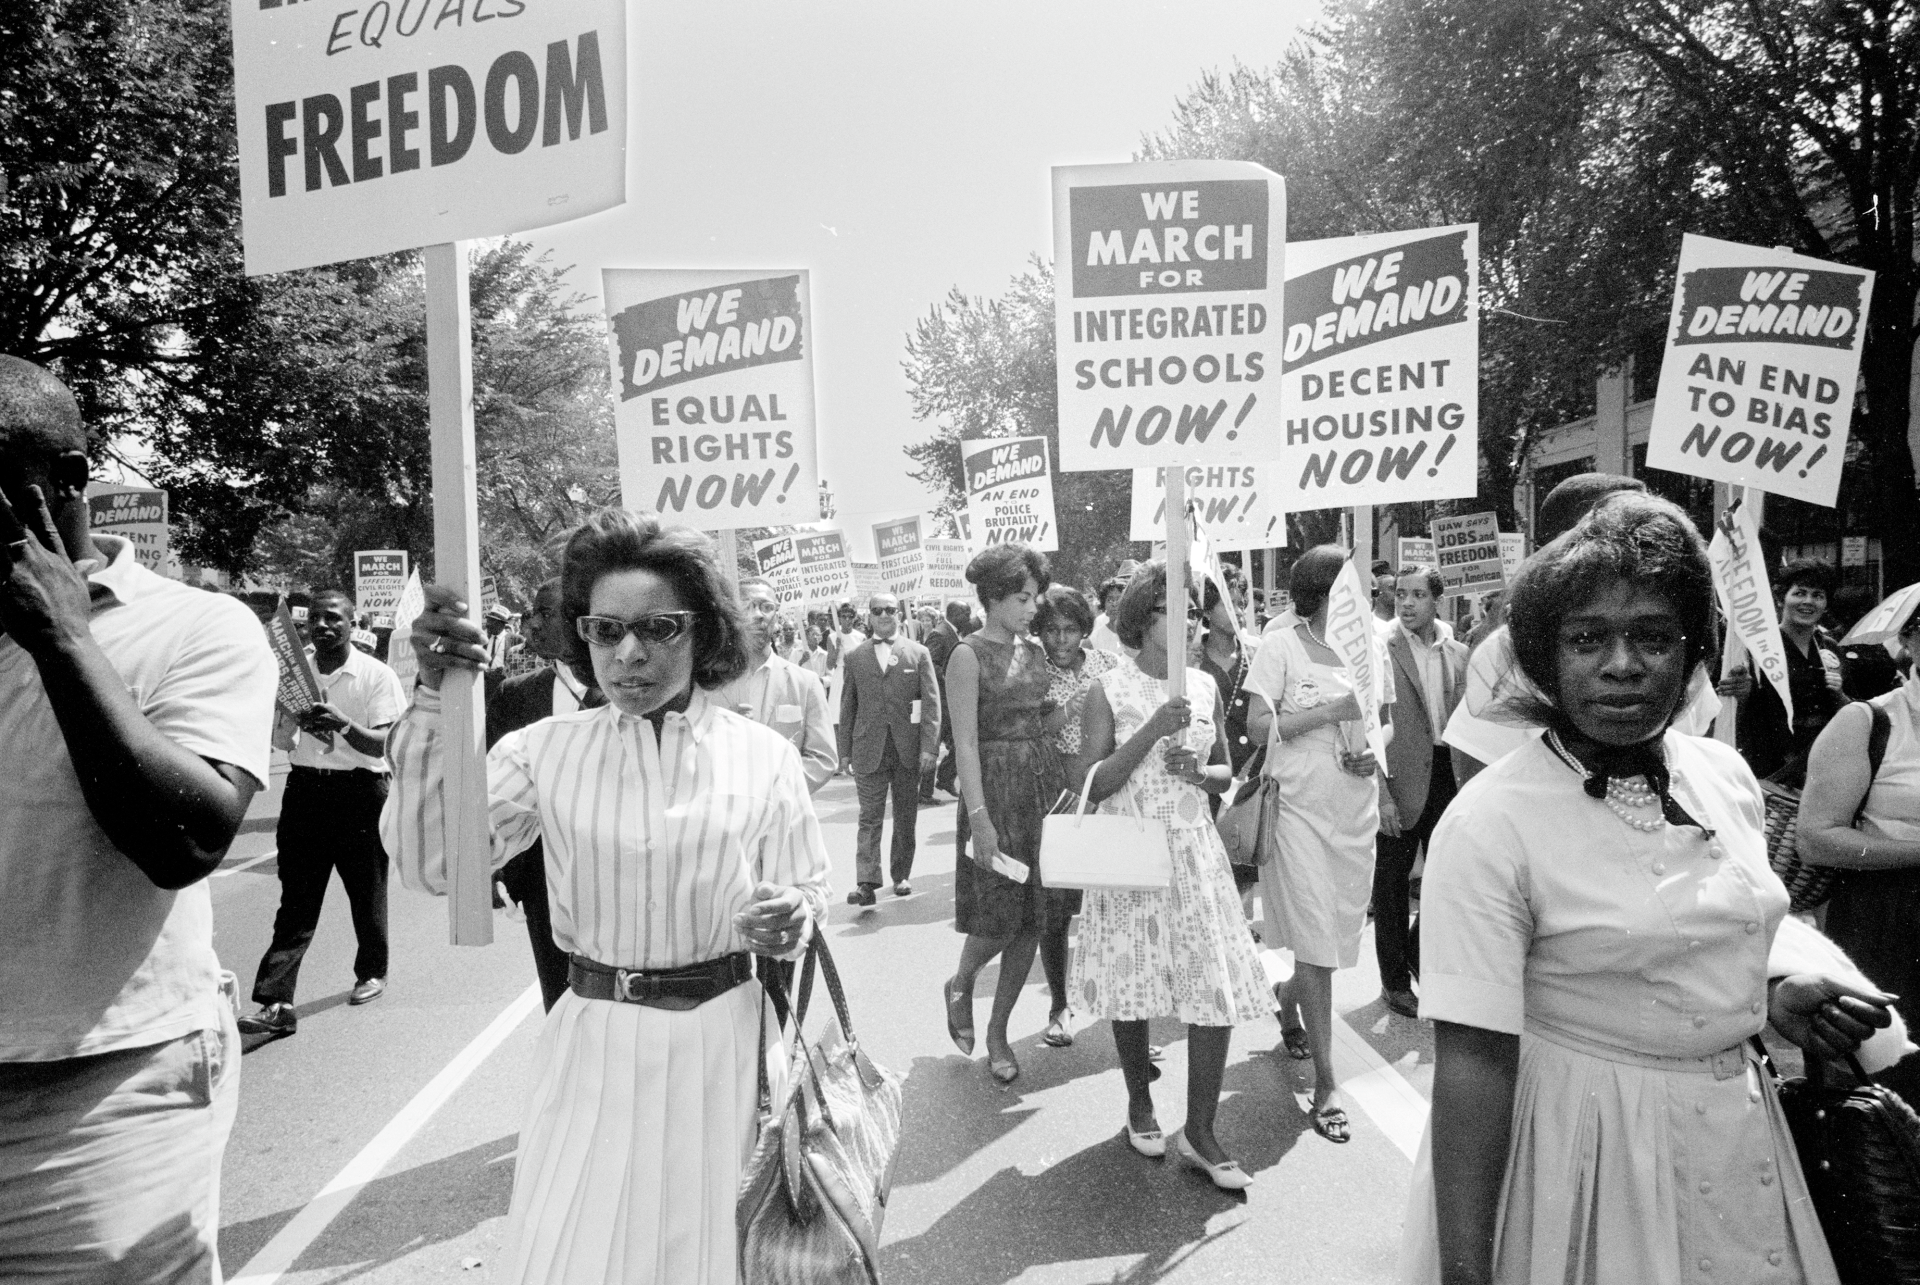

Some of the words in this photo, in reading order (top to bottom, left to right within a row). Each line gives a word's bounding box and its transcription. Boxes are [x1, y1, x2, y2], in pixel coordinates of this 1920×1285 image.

[265, 29, 608, 199] FREEDOM
[1141, 190, 1199, 221] WE
[1086, 224, 1253, 266] MARCH
[1139, 269, 1204, 288] FOR
[1332, 251, 1404, 305] WE
[1739, 270, 1810, 302] WE
[676, 288, 743, 334] WE
[1283, 275, 1462, 363] DEMAND
[1687, 303, 1853, 338] DEMAND
[1073, 303, 1267, 343] INTEGRATED
[632, 316, 797, 386] DEMAND
[1074, 351, 1265, 391] SCHOOLS
[1301, 359, 1451, 401] DECENT
[1687, 352, 1747, 386] AN
[1759, 364, 1841, 405] END
[651, 393, 787, 426] EQUAL
[1089, 392, 1257, 449] NOW!
[1687, 385, 1736, 418] TO
[1746, 397, 1833, 440] BIAS
[1286, 402, 1465, 446] HOUSING
[651, 430, 794, 464] RIGHTS
[991, 443, 1020, 466] WE
[1680, 423, 1828, 479] NOW!
[973, 455, 1043, 490] DEMAND
[1298, 433, 1457, 490] NOW!
[655, 462, 801, 514] NOW!
[1155, 466, 1255, 488] RGHTS
[112, 494, 140, 508] WE
[980, 491, 1005, 502] AN
[1008, 488, 1040, 500] END
[93, 505, 161, 525] DEMAND
[994, 504, 1032, 516] POLICE
[1153, 491, 1257, 525] W!
[892, 526, 904, 535] WE
[984, 514, 1039, 528] BRUTALITY
[1438, 521, 1463, 532] UAW
[1466, 517, 1490, 527] SAYS
[811, 537, 826, 546] WE
[882, 532, 917, 549] MARCH
[985, 521, 1049, 546] NOW!
[1437, 530, 1477, 549] JOBS
[1479, 531, 1495, 541] and
[772, 540, 790, 555] WE
[801, 543, 840, 557] MARCH
[893, 545, 907, 553] FOR
[1404, 549, 1435, 557] MARCH
[1439, 545, 1499, 566] FREEDOM
[361, 562, 400, 572] MARCH
[763, 549, 795, 571] DEMA
[801, 560, 847, 574] INTEGRATED
[881, 559, 901, 570] FIRST
[902, 552, 923, 565] CLASS
[1461, 564, 1480, 572] FOR
[768, 569, 783, 578] AN
[785, 567, 798, 575] EN
[777, 576, 800, 585] POLICE
[803, 571, 849, 586] SCHOOLS
[881, 562, 925, 581] CITIZENSHIP
[1465, 571, 1501, 584] American
[810, 580, 849, 599] NOW!
[890, 575, 923, 595] NOW!
[929, 578, 964, 588] REEDOM
[271, 615, 295, 658] MARCH
[1327, 584, 1371, 693] FREEDOM
[1756, 638, 1770, 654] IN
[1763, 652, 1785, 683] '63
